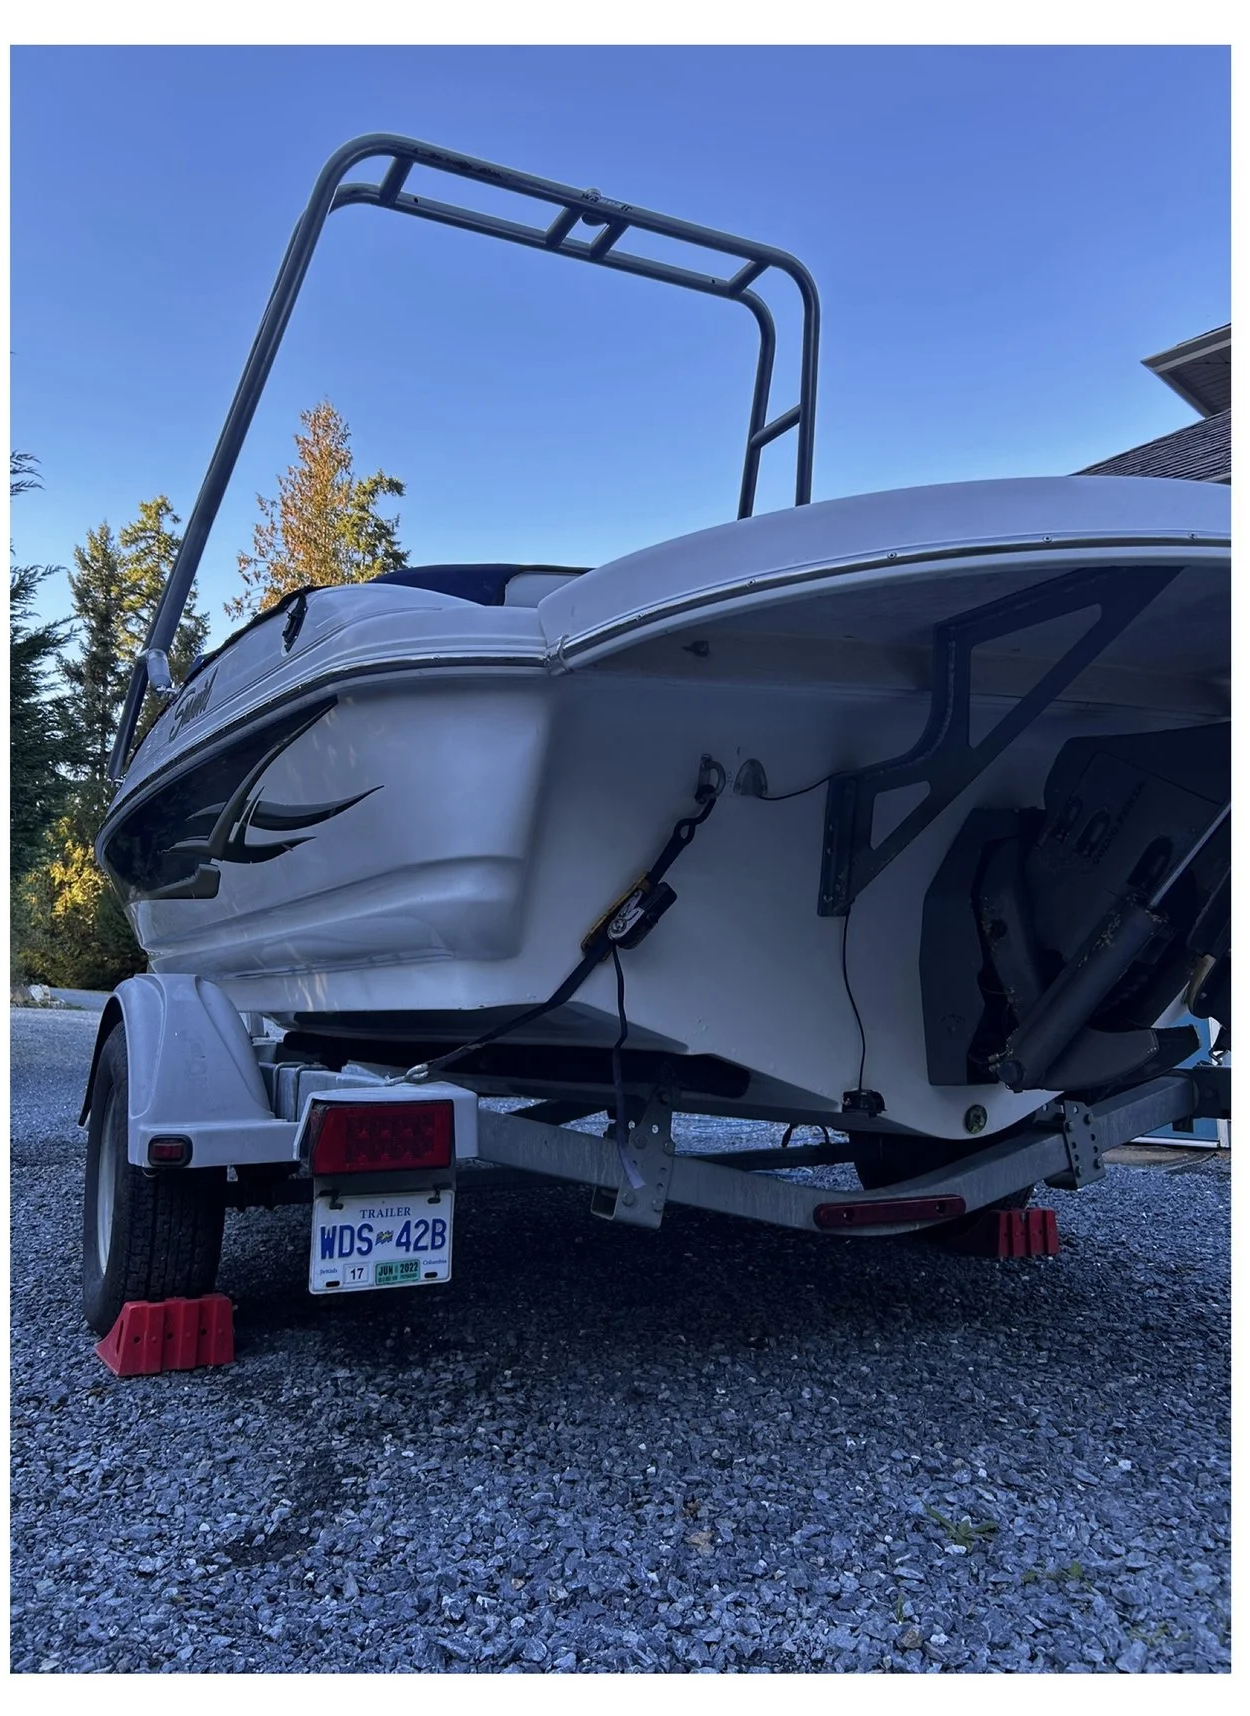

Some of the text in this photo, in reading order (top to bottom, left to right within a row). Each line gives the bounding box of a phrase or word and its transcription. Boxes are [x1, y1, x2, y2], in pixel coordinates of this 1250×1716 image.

[360, 1207, 411, 1219] TRAILER
[320, 1218, 447, 1260] WDS 42B
[350, 1267, 364, 1280] 17
[378, 1261, 419, 1277] JUN 2022
